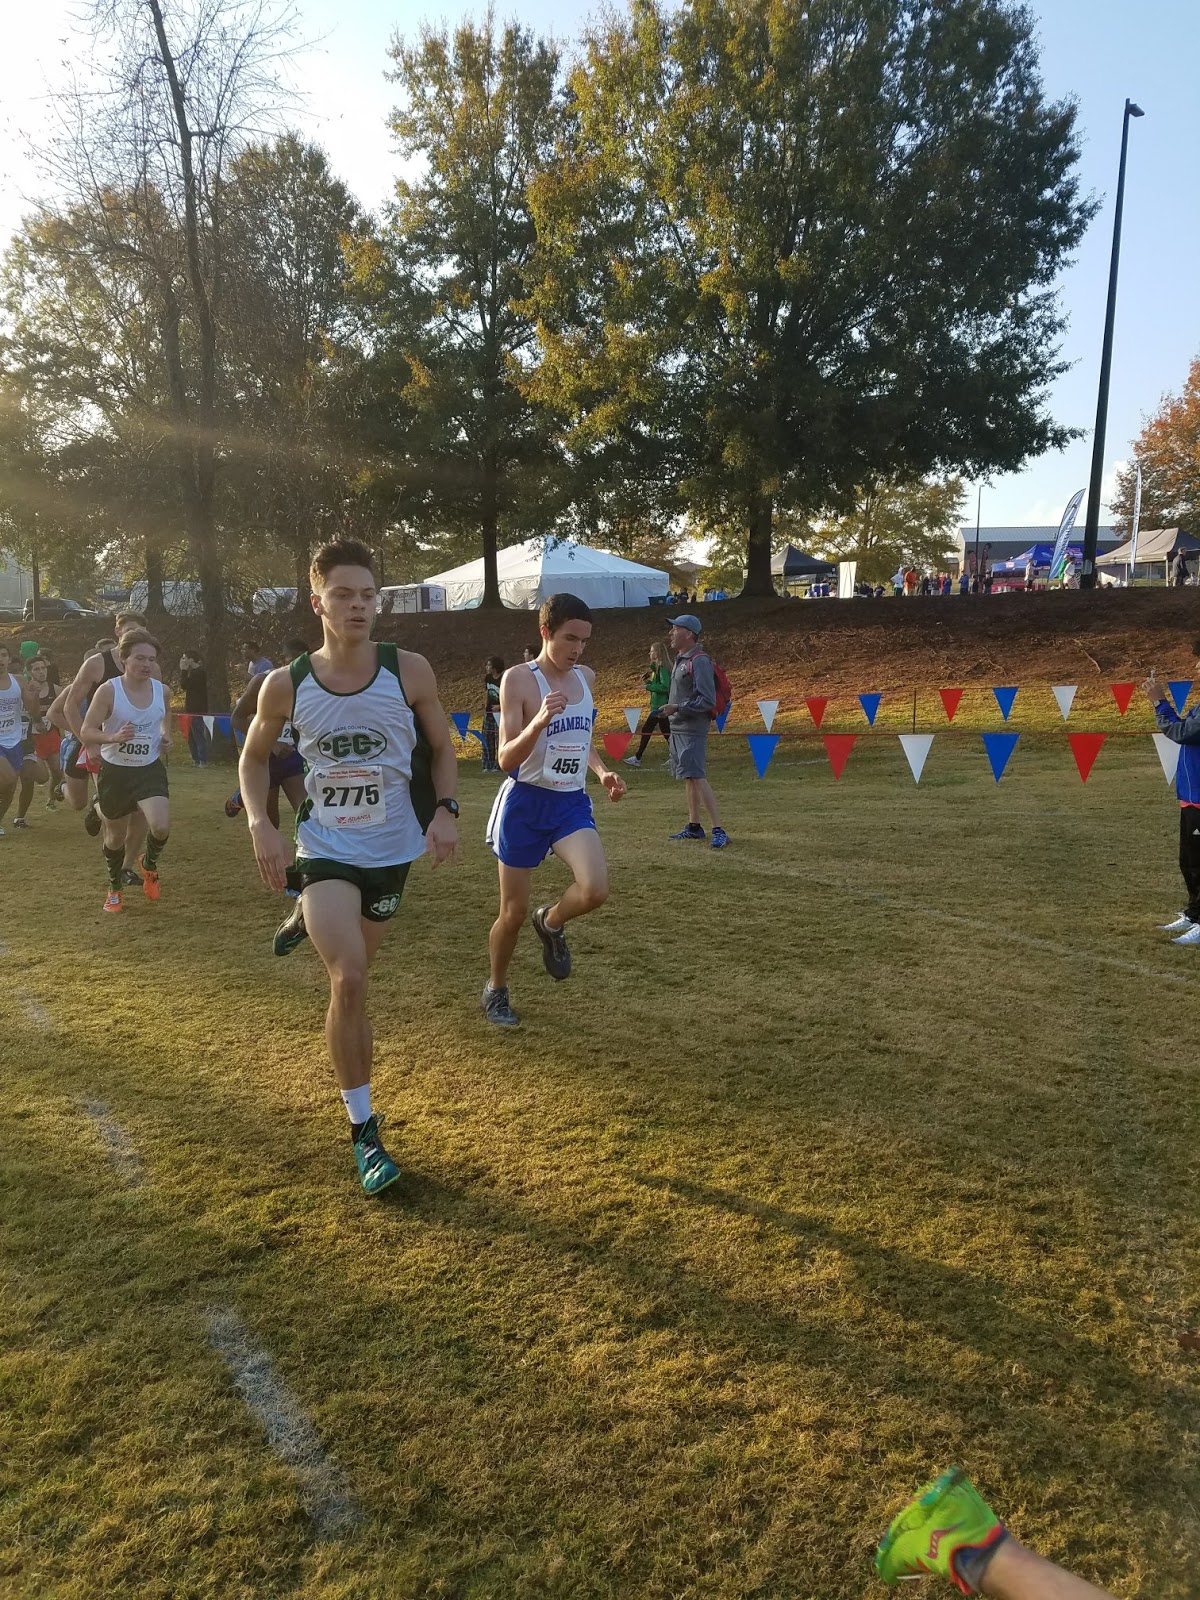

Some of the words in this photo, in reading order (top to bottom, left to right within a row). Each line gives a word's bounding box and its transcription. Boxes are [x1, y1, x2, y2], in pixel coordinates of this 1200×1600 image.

[118, 742, 149, 755] 2033
[551, 758, 580, 775] 455
[322, 784, 380, 807] 2775
